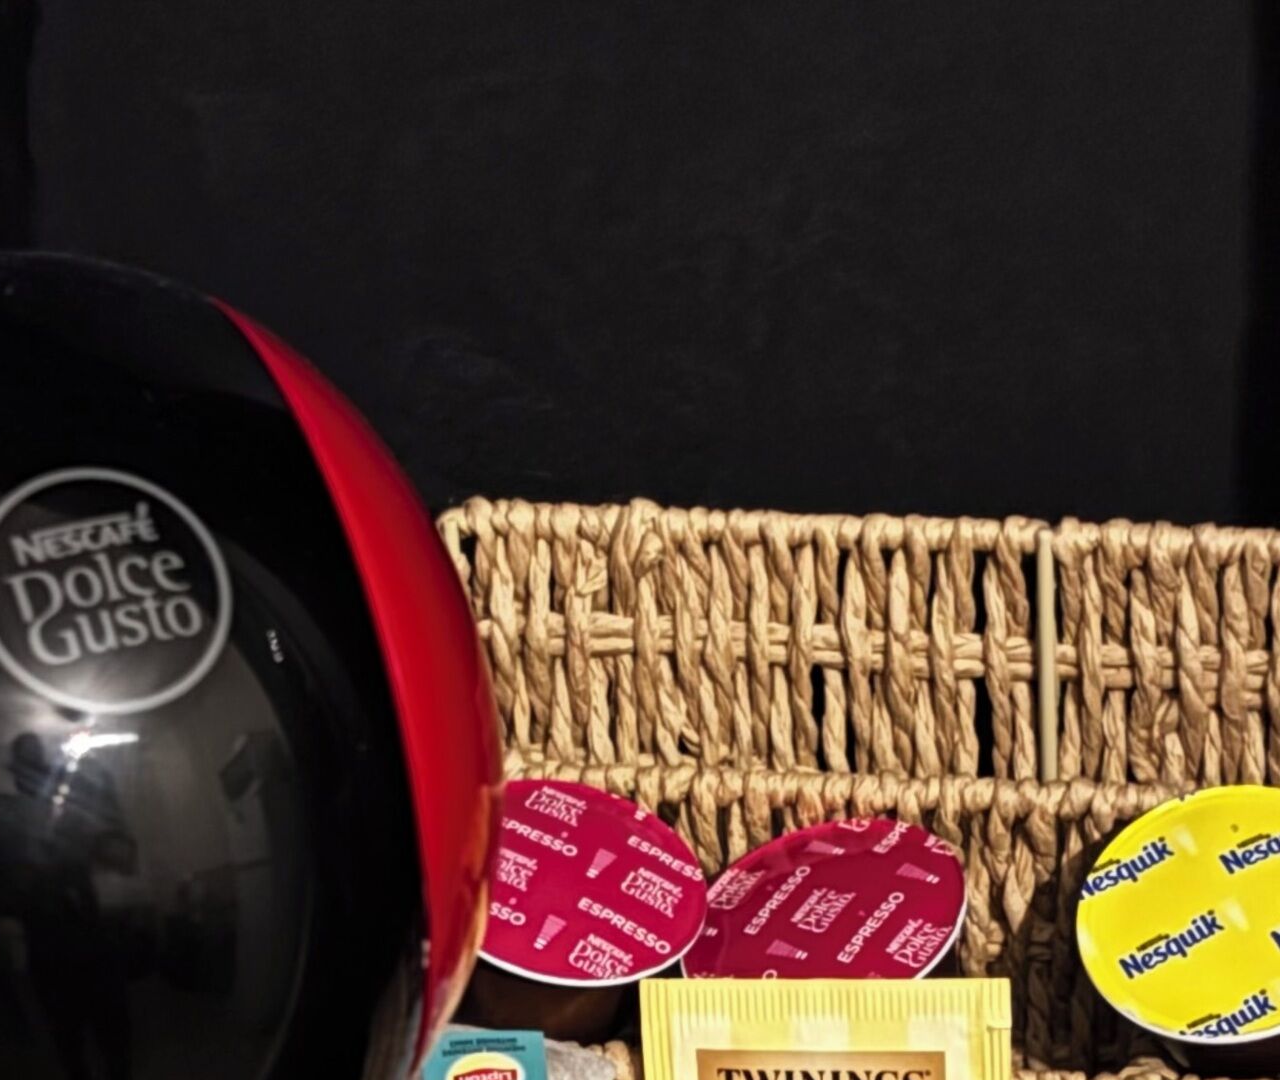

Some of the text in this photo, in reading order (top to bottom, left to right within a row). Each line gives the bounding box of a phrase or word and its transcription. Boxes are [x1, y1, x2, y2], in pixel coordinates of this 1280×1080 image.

[10, 502, 159, 566] NESCAFÉ
[3, 550, 191, 623] Dolce
[27, 596, 203, 665] Gusto
[578, 896, 671, 955] ESPRESSO
[743, 866, 811, 935] ESPRESSO
[837, 892, 905, 964] ESPRESSO
[1119, 911, 1224, 979] Nesquik
